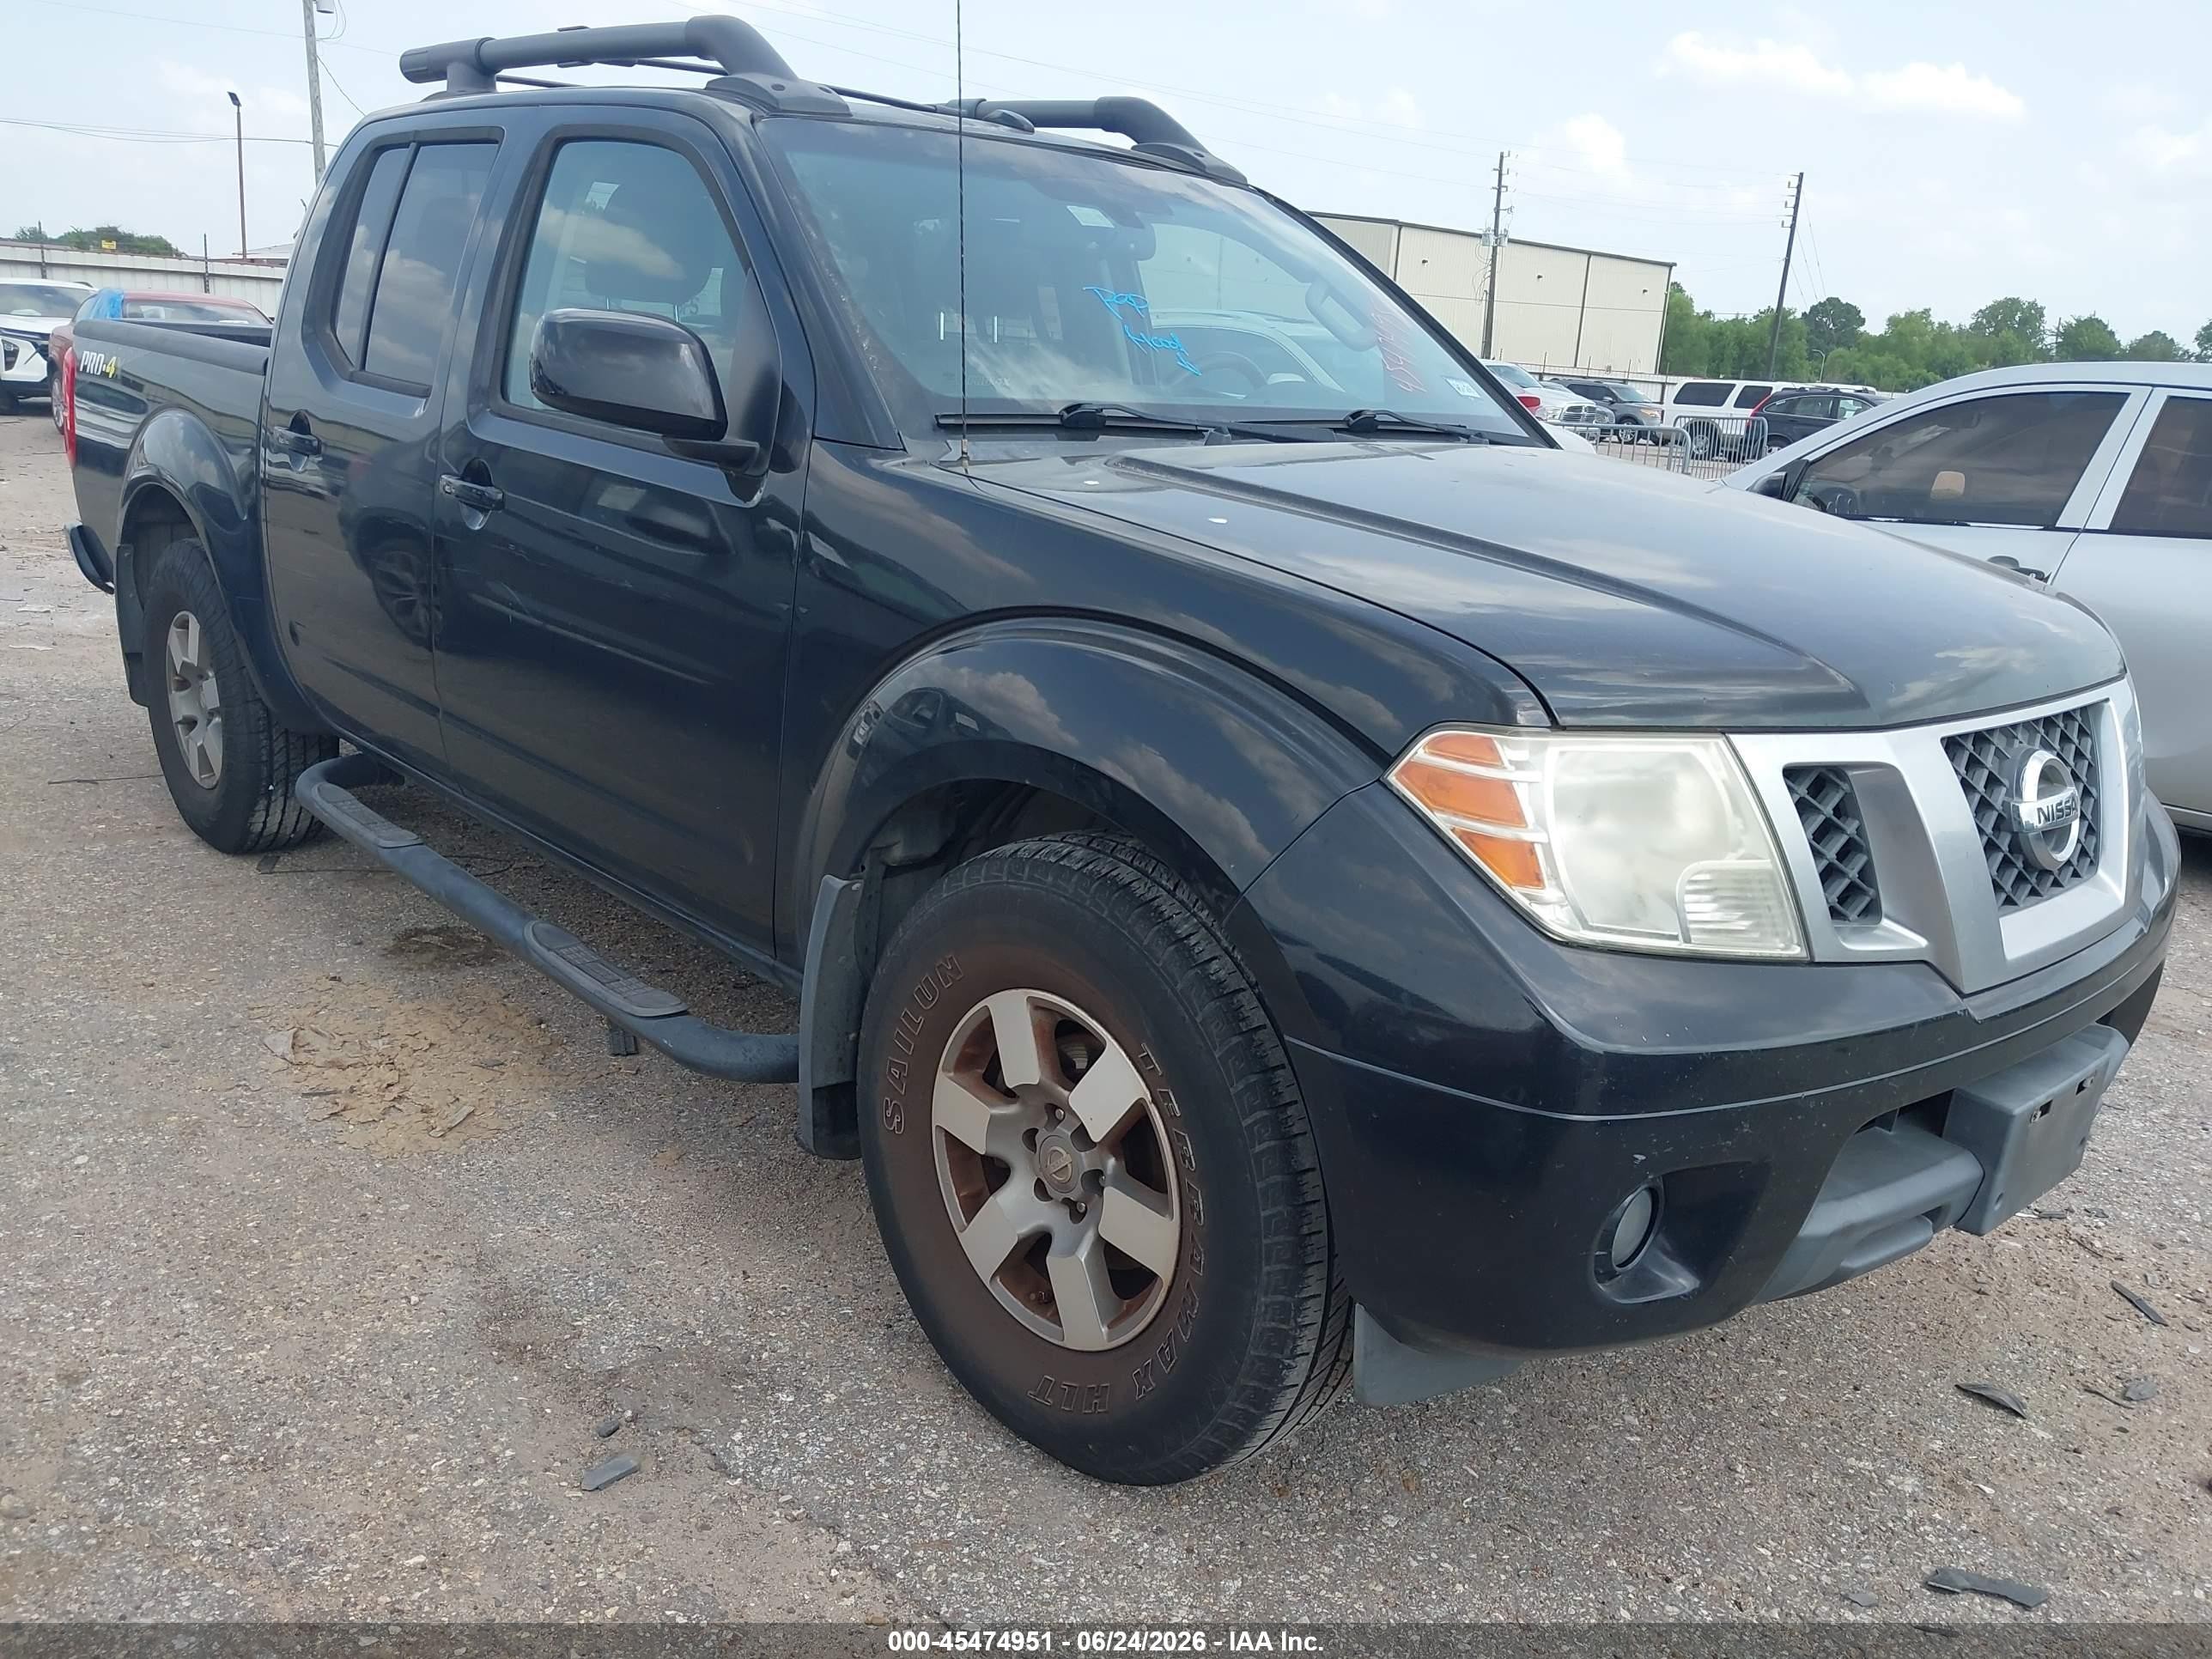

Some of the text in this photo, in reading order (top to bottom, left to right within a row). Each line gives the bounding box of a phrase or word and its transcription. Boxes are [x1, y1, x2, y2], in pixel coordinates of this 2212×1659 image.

[2036, 795, 2076, 825] NISSA
[883, 954, 964, 1134] SAILUN
[1027, 1042, 1205, 1414] TERRAMAX HLT
